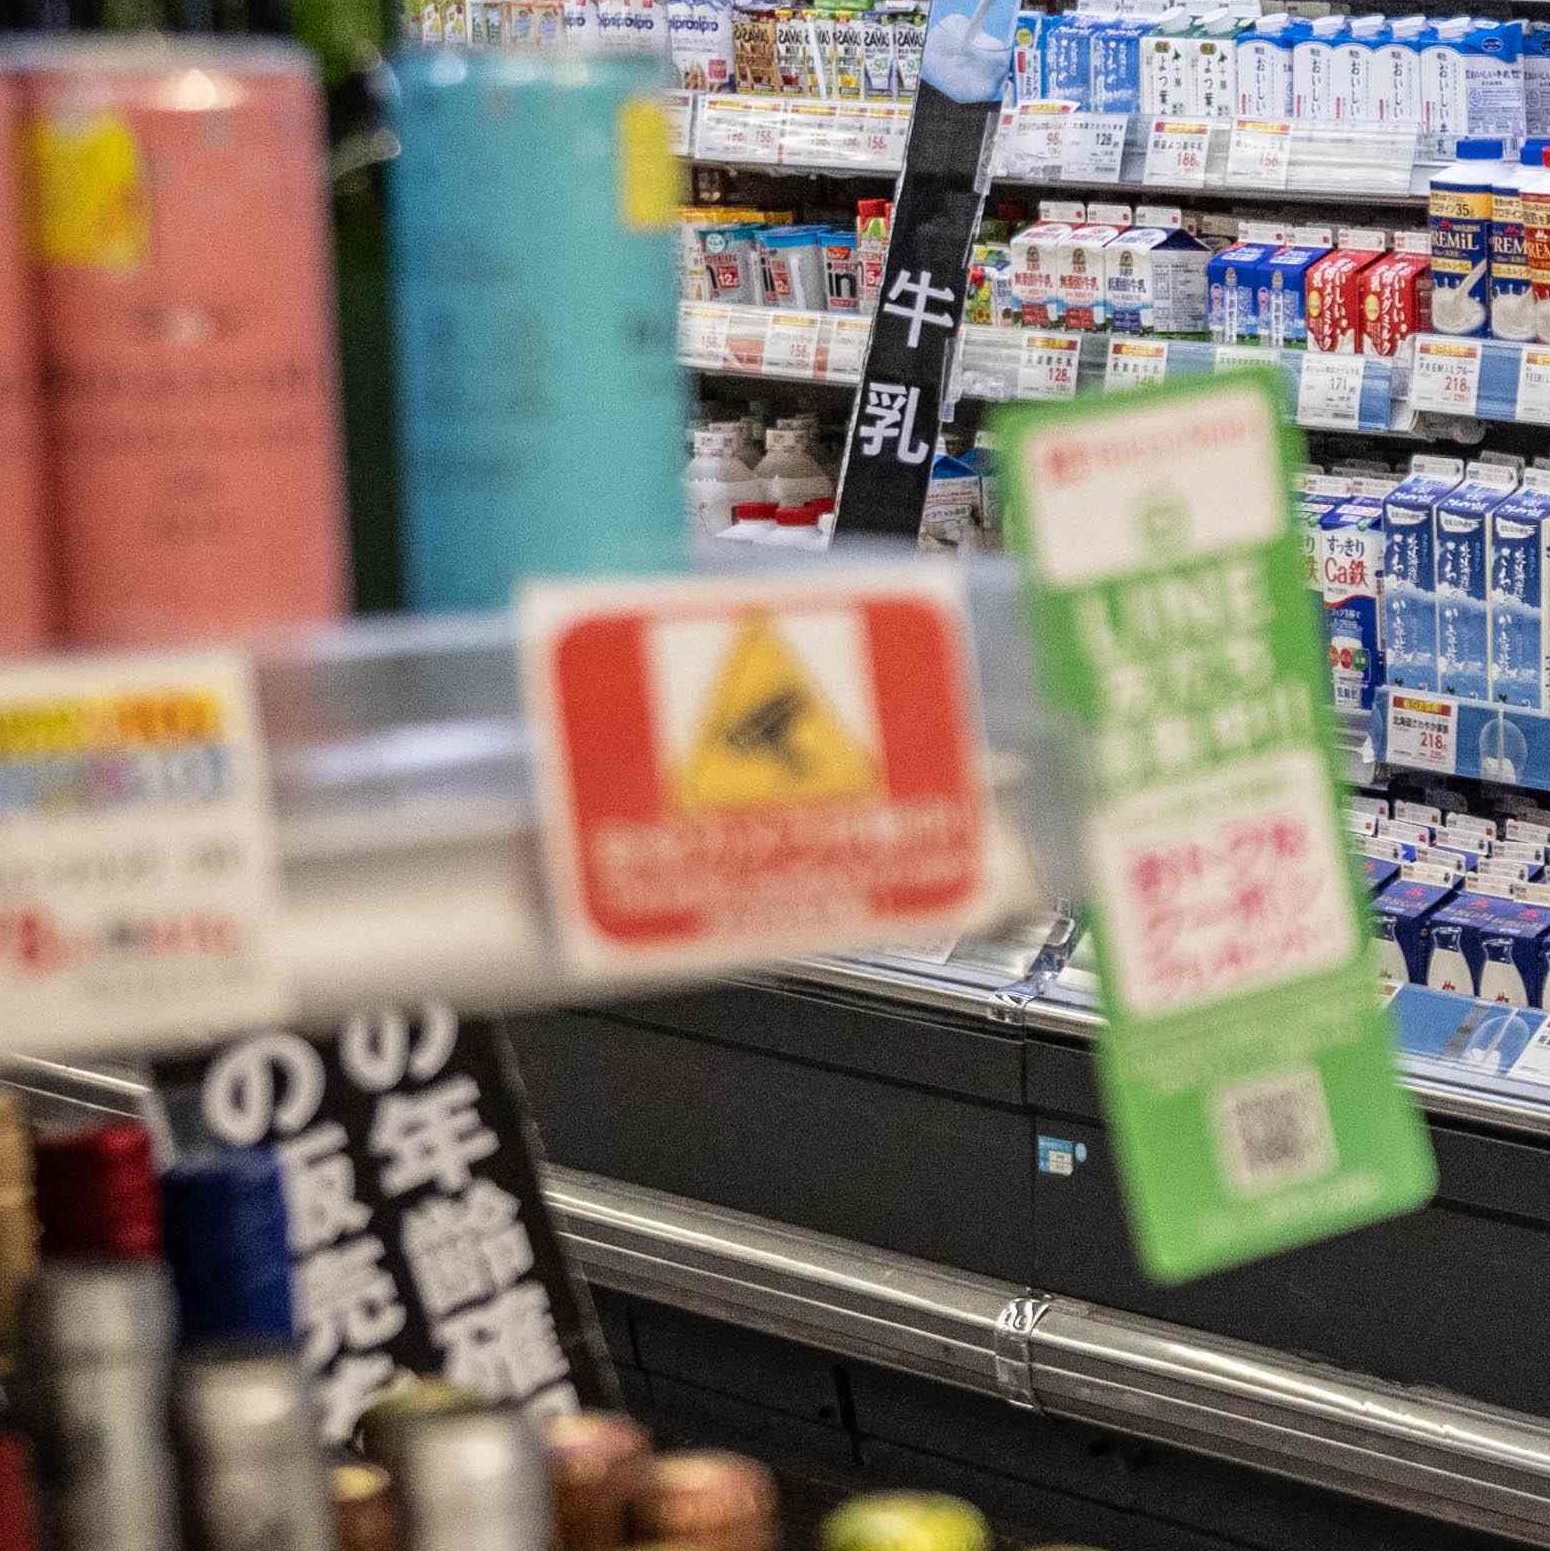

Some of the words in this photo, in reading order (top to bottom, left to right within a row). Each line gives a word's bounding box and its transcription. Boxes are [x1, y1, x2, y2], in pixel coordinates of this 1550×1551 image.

[858, 269, 954, 464] 牛乳
[1328, 534, 1365, 557] すっきり
[1324, 555, 1368, 589] Ca鉄
